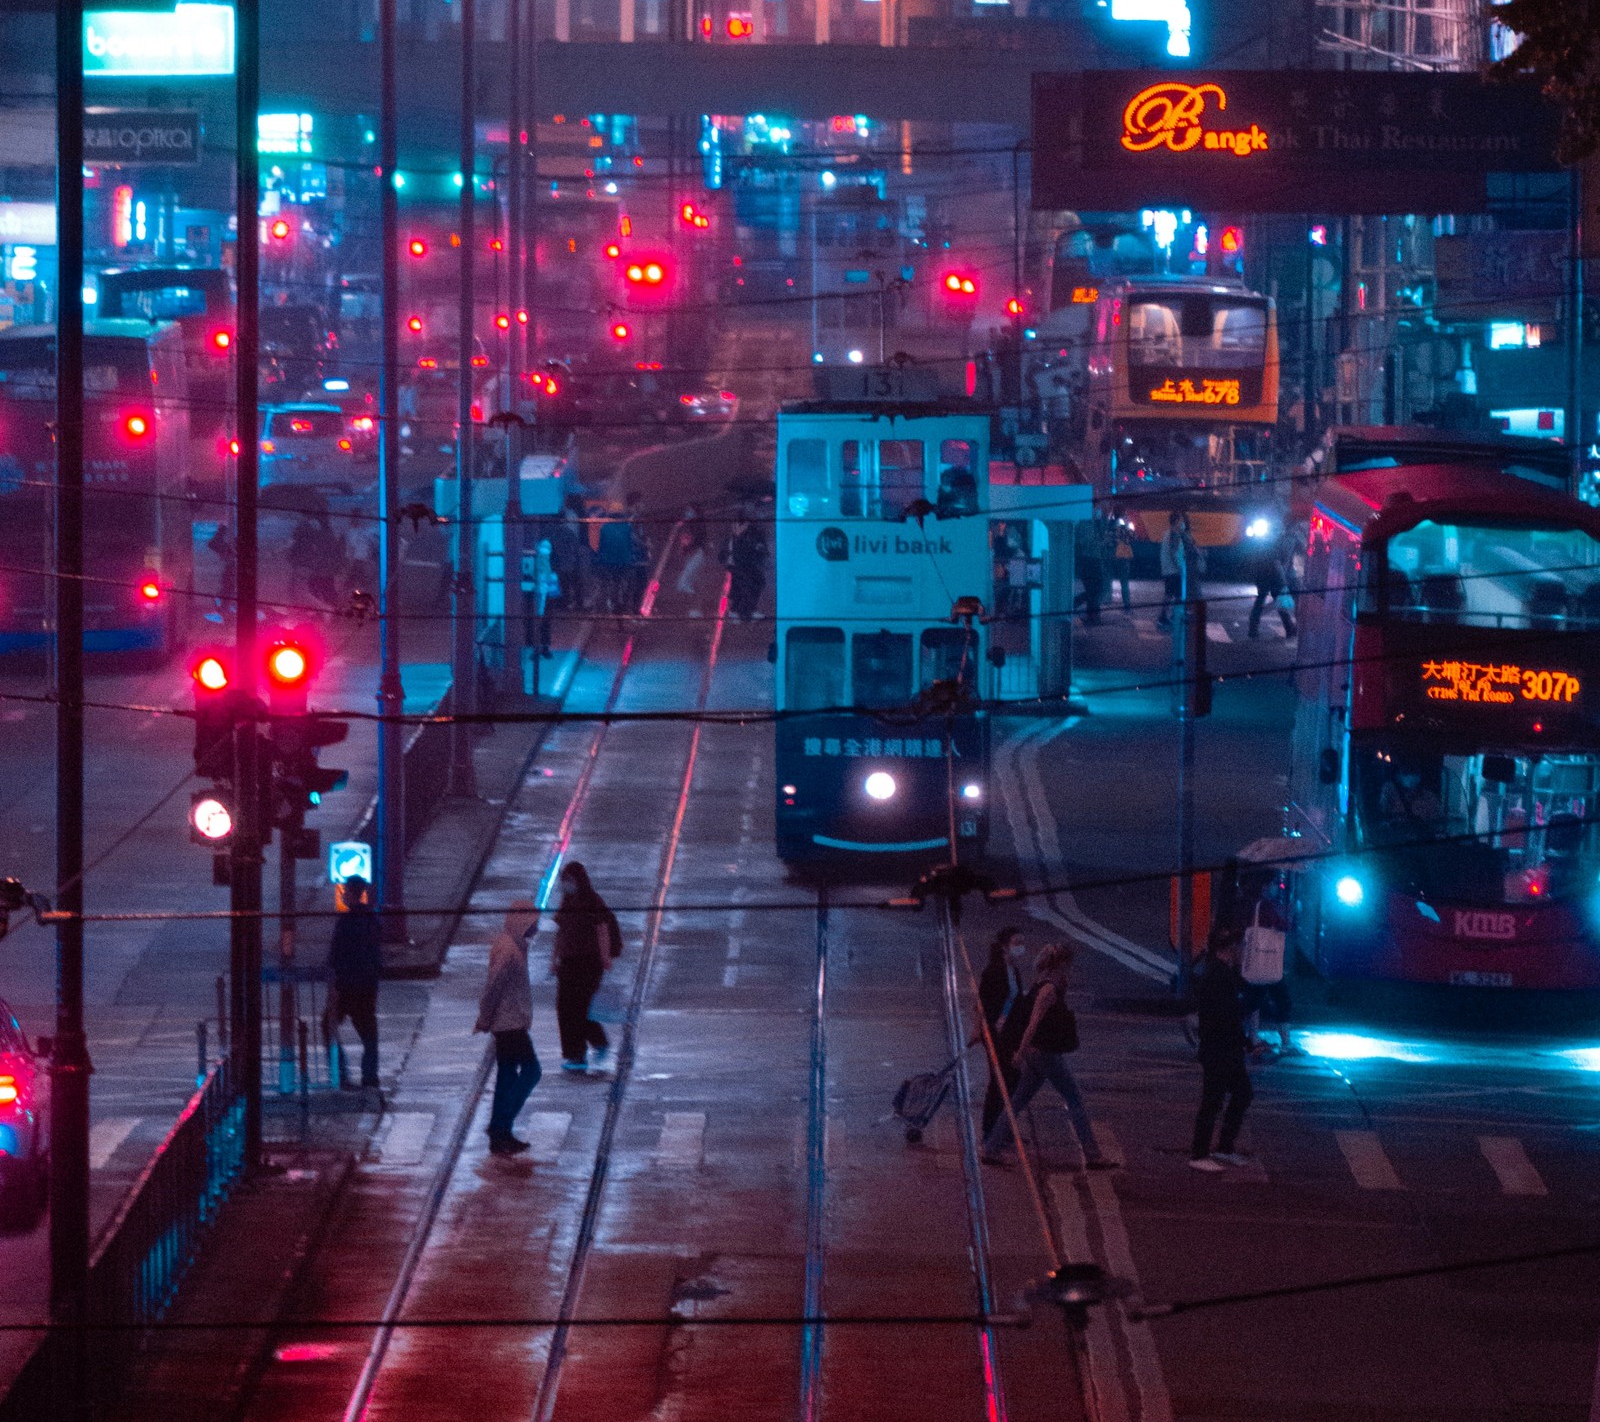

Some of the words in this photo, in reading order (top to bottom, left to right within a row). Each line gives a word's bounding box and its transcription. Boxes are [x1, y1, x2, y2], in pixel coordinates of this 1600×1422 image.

[1203, 387, 1240, 405] 678
[854, 535, 889, 554] livi
[895, 535, 953, 555] bank
[1521, 670, 1580, 702] 307P
[1455, 911, 1516, 939] KMB
